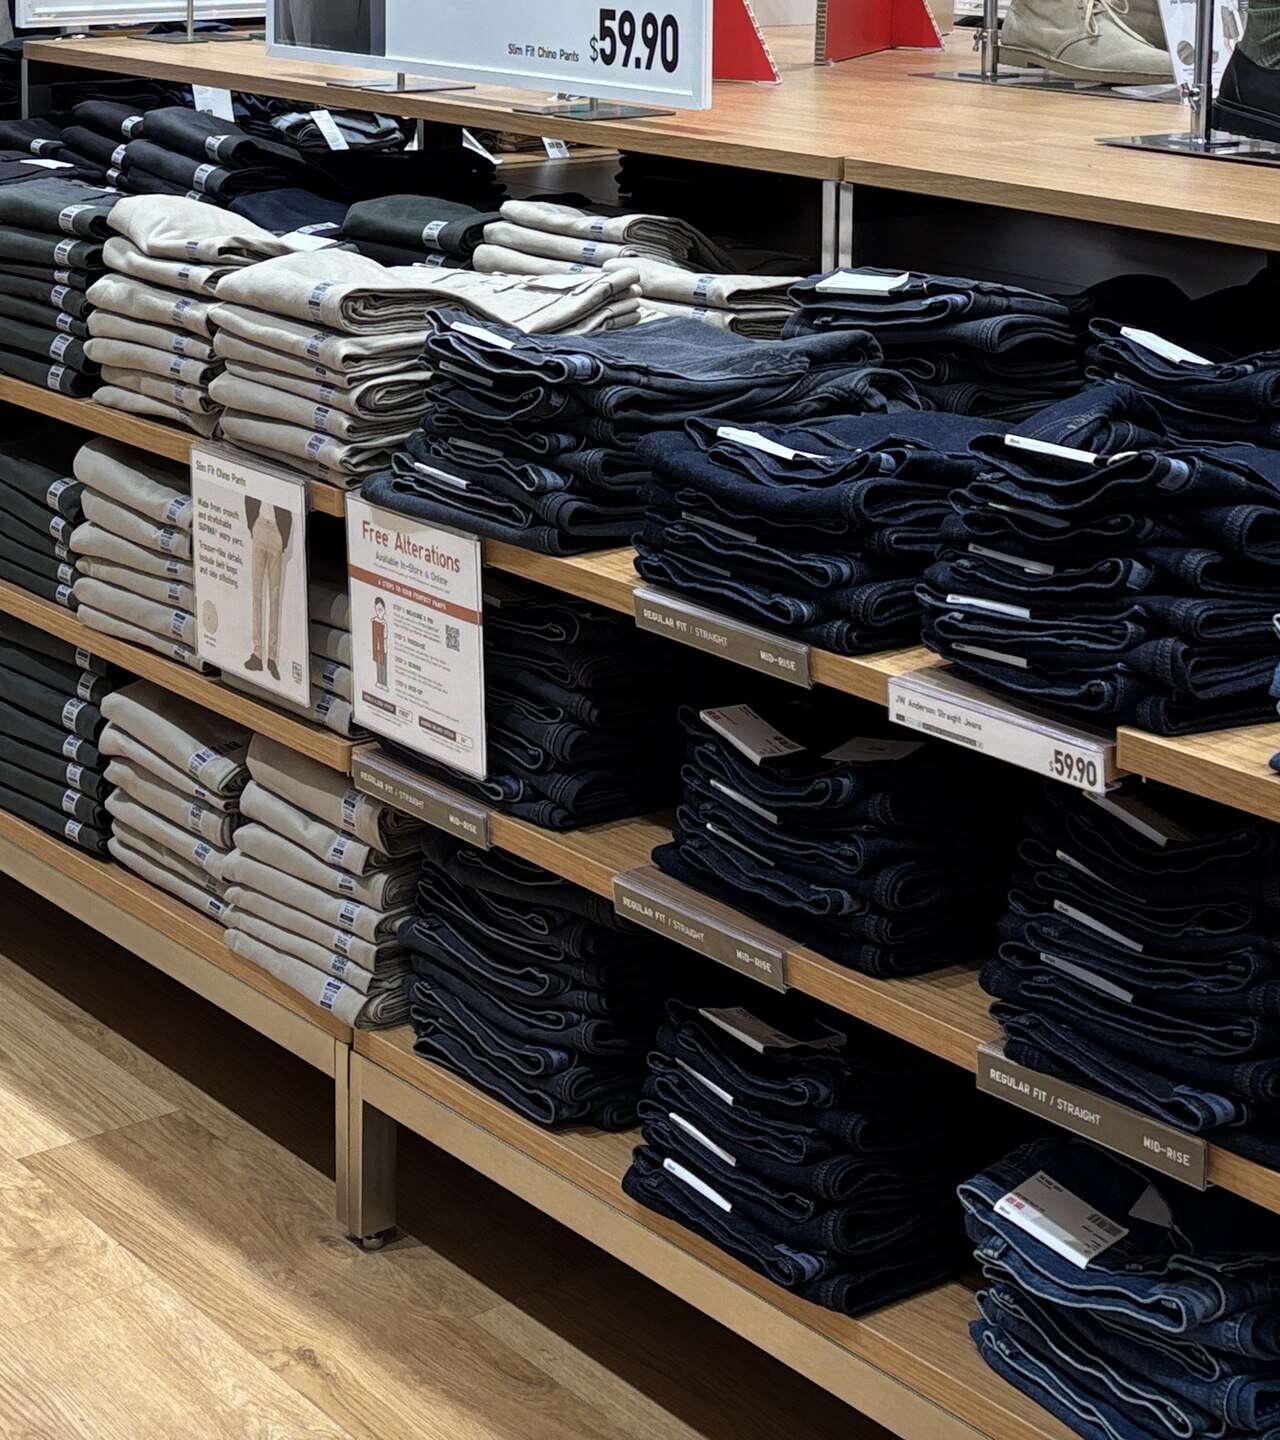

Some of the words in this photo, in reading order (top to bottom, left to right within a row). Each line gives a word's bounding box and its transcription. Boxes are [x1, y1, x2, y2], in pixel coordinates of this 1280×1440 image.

[508, 42, 524, 57] Slim
[525, 44, 536, 58] Fit
[537, 46, 558, 60] Chino
[560, 49, 580, 63] Pants
[589, 7, 679, 73] $59.90
[361, 519, 390, 548] Free
[394, 531, 462, 574] Alterations
[643, 608, 675, 631] REGULAR
[675, 621, 688, 633] FIT
[695, 626, 728, 647] STRAIGHT
[759, 650, 797, 671] MID-RISE
[1048, 748, 1098, 788] $59.90
[622, 895, 654, 919] REGULAR
[655, 910, 666, 924] FIT
[989, 1067, 1031, 1096] REGULAR
[1032, 1086, 1048, 1104] FIT
[1055, 1097, 1102, 1126] STRAIGHT
[1142, 1135, 1191, 1167] MID-RISE
